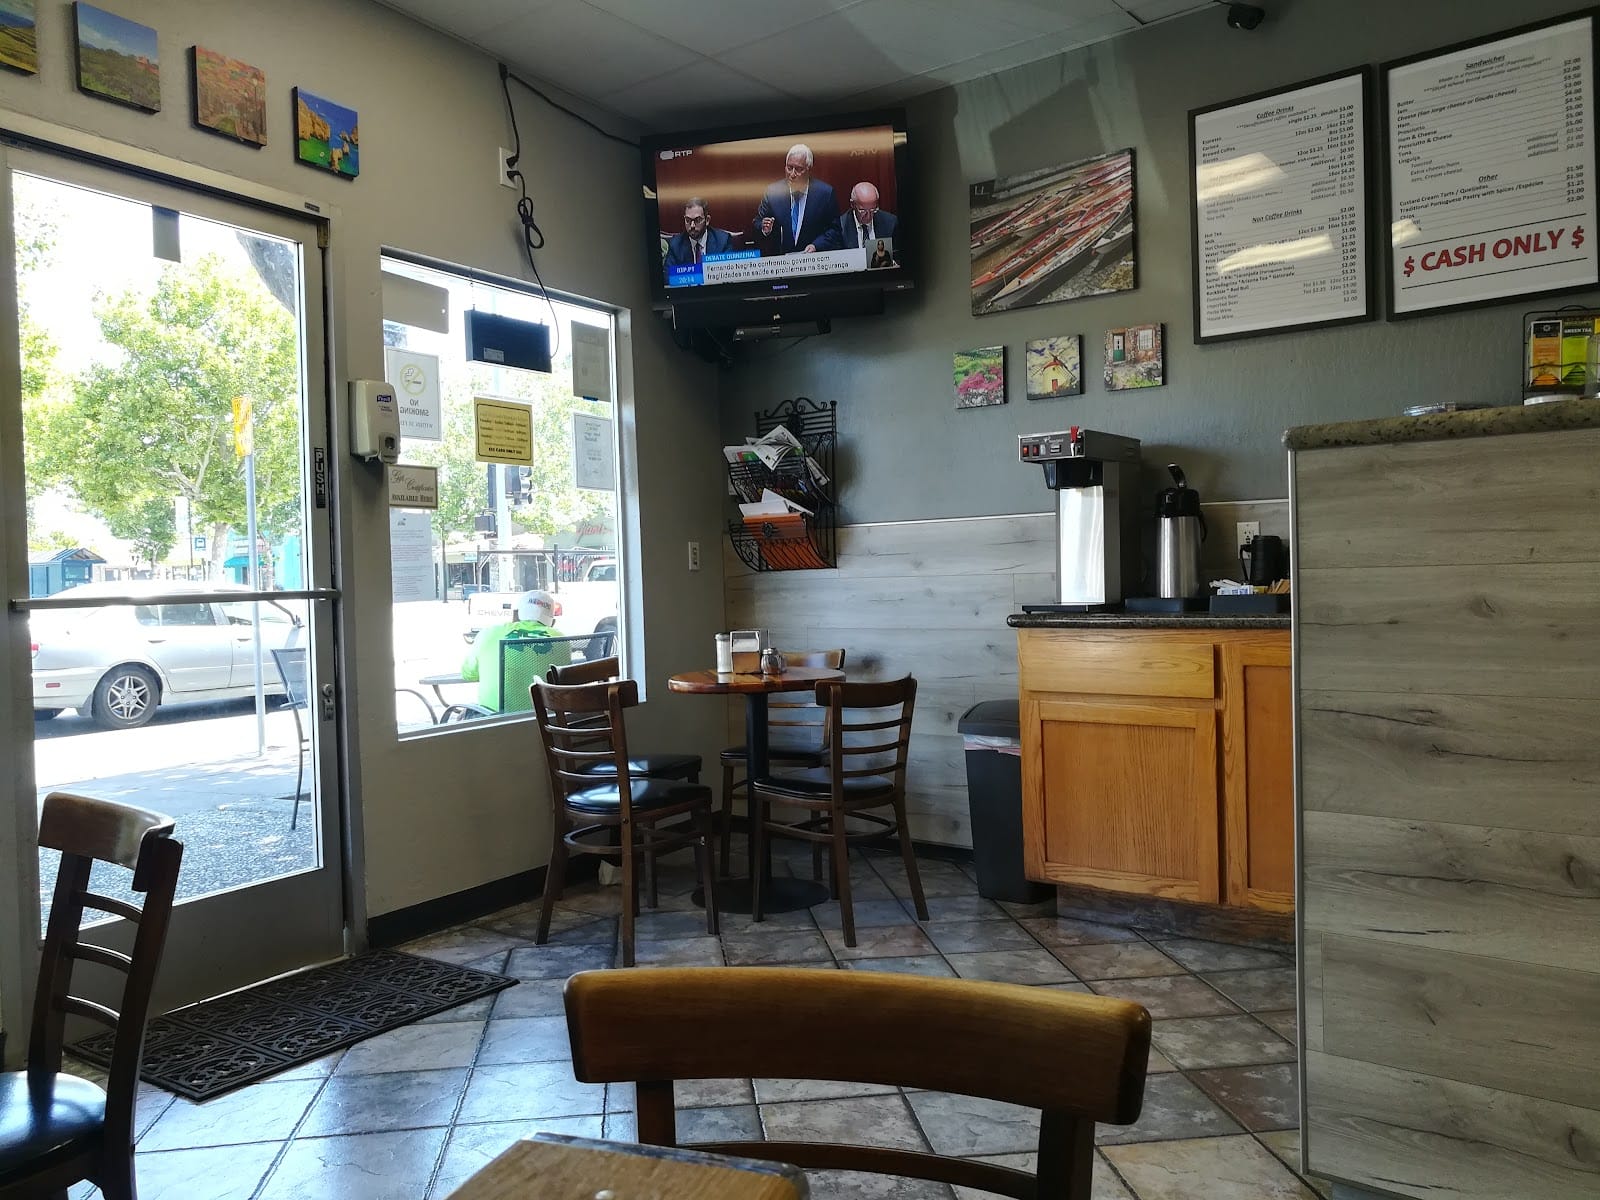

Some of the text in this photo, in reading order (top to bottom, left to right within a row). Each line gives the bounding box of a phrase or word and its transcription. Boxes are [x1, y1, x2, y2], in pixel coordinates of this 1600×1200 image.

[1465, 55, 1506, 69] Sandwiches
[1256, 110, 1274, 119] Coffee
[1478, 173, 1498, 183] Other
[1404, 226, 1584, 277] $ CASH ONLY $
[707, 264, 734, 272] Fernando
[758, 258, 790, 268] confrontou
[792, 257, 816, 265] governo
[708, 270, 742, 280] fragilidades
[776, 264, 806, 275] problemas
[817, 260, 849, 271] Segurança
[315, 451, 324, 494] PUSH
